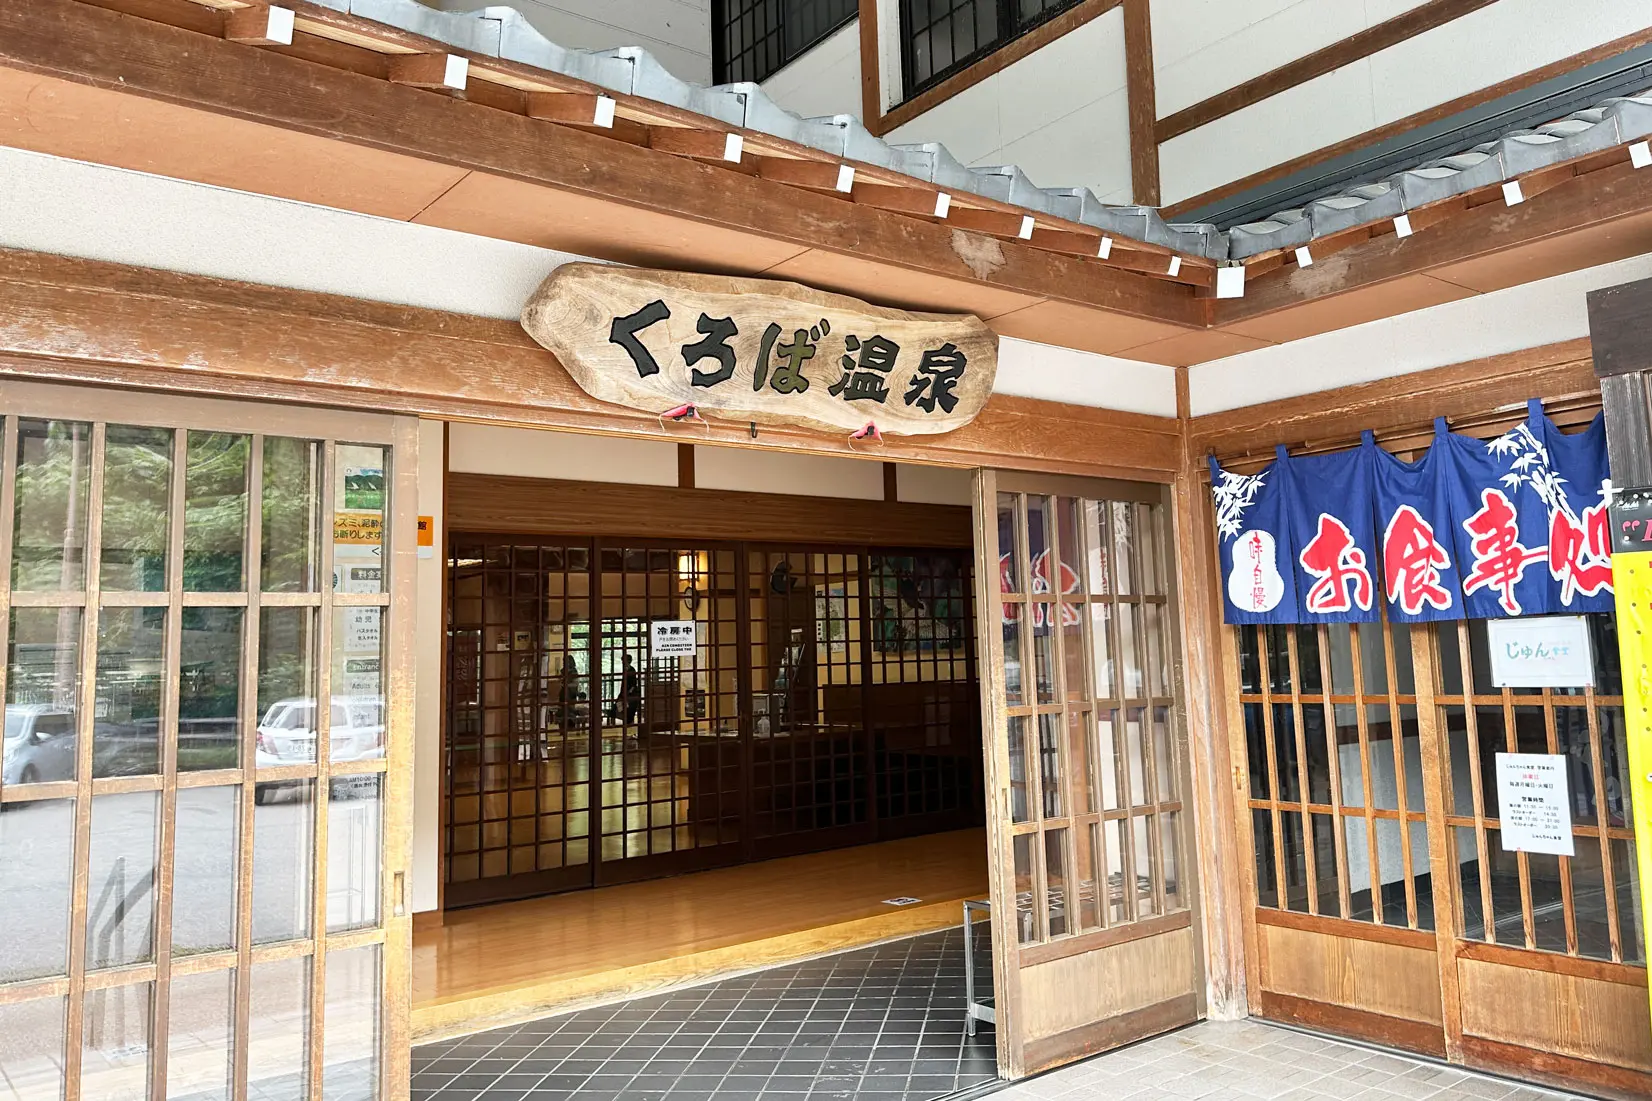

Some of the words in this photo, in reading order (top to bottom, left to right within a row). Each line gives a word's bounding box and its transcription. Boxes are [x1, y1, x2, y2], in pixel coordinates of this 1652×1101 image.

[608, 299, 968, 414] くろば温泉
[1248, 531, 1268, 609] 味自慢
[657, 626, 692, 635] 冷房中
